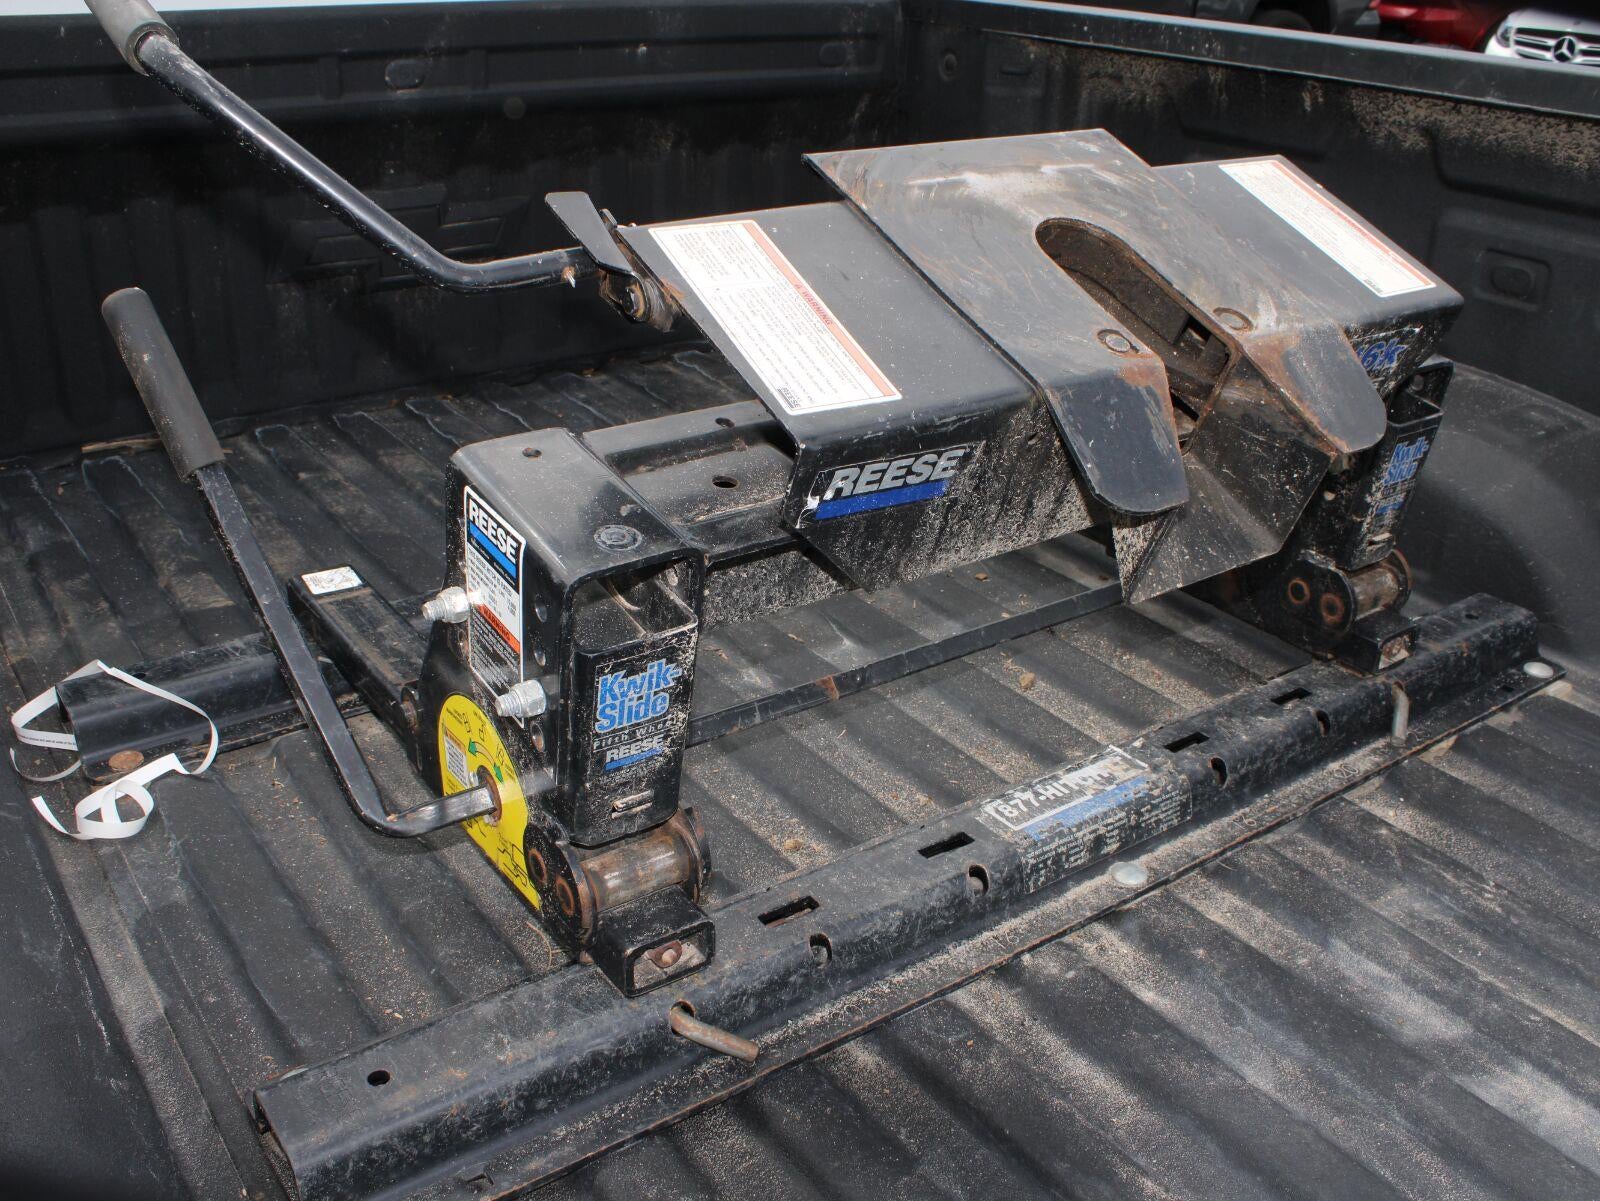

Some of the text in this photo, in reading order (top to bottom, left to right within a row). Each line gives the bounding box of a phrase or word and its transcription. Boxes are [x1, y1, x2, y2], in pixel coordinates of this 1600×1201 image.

[802, 286, 833, 326] WARNING
[781, 386, 801, 408] REESE
[823, 449, 966, 500] REESE
[468, 498, 518, 564] REESE
[483, 608, 511, 642] WARNING
[598, 658, 684, 706] Kwik-
[595, 691, 670, 734] Slide
[605, 733, 665, 764] REESE
